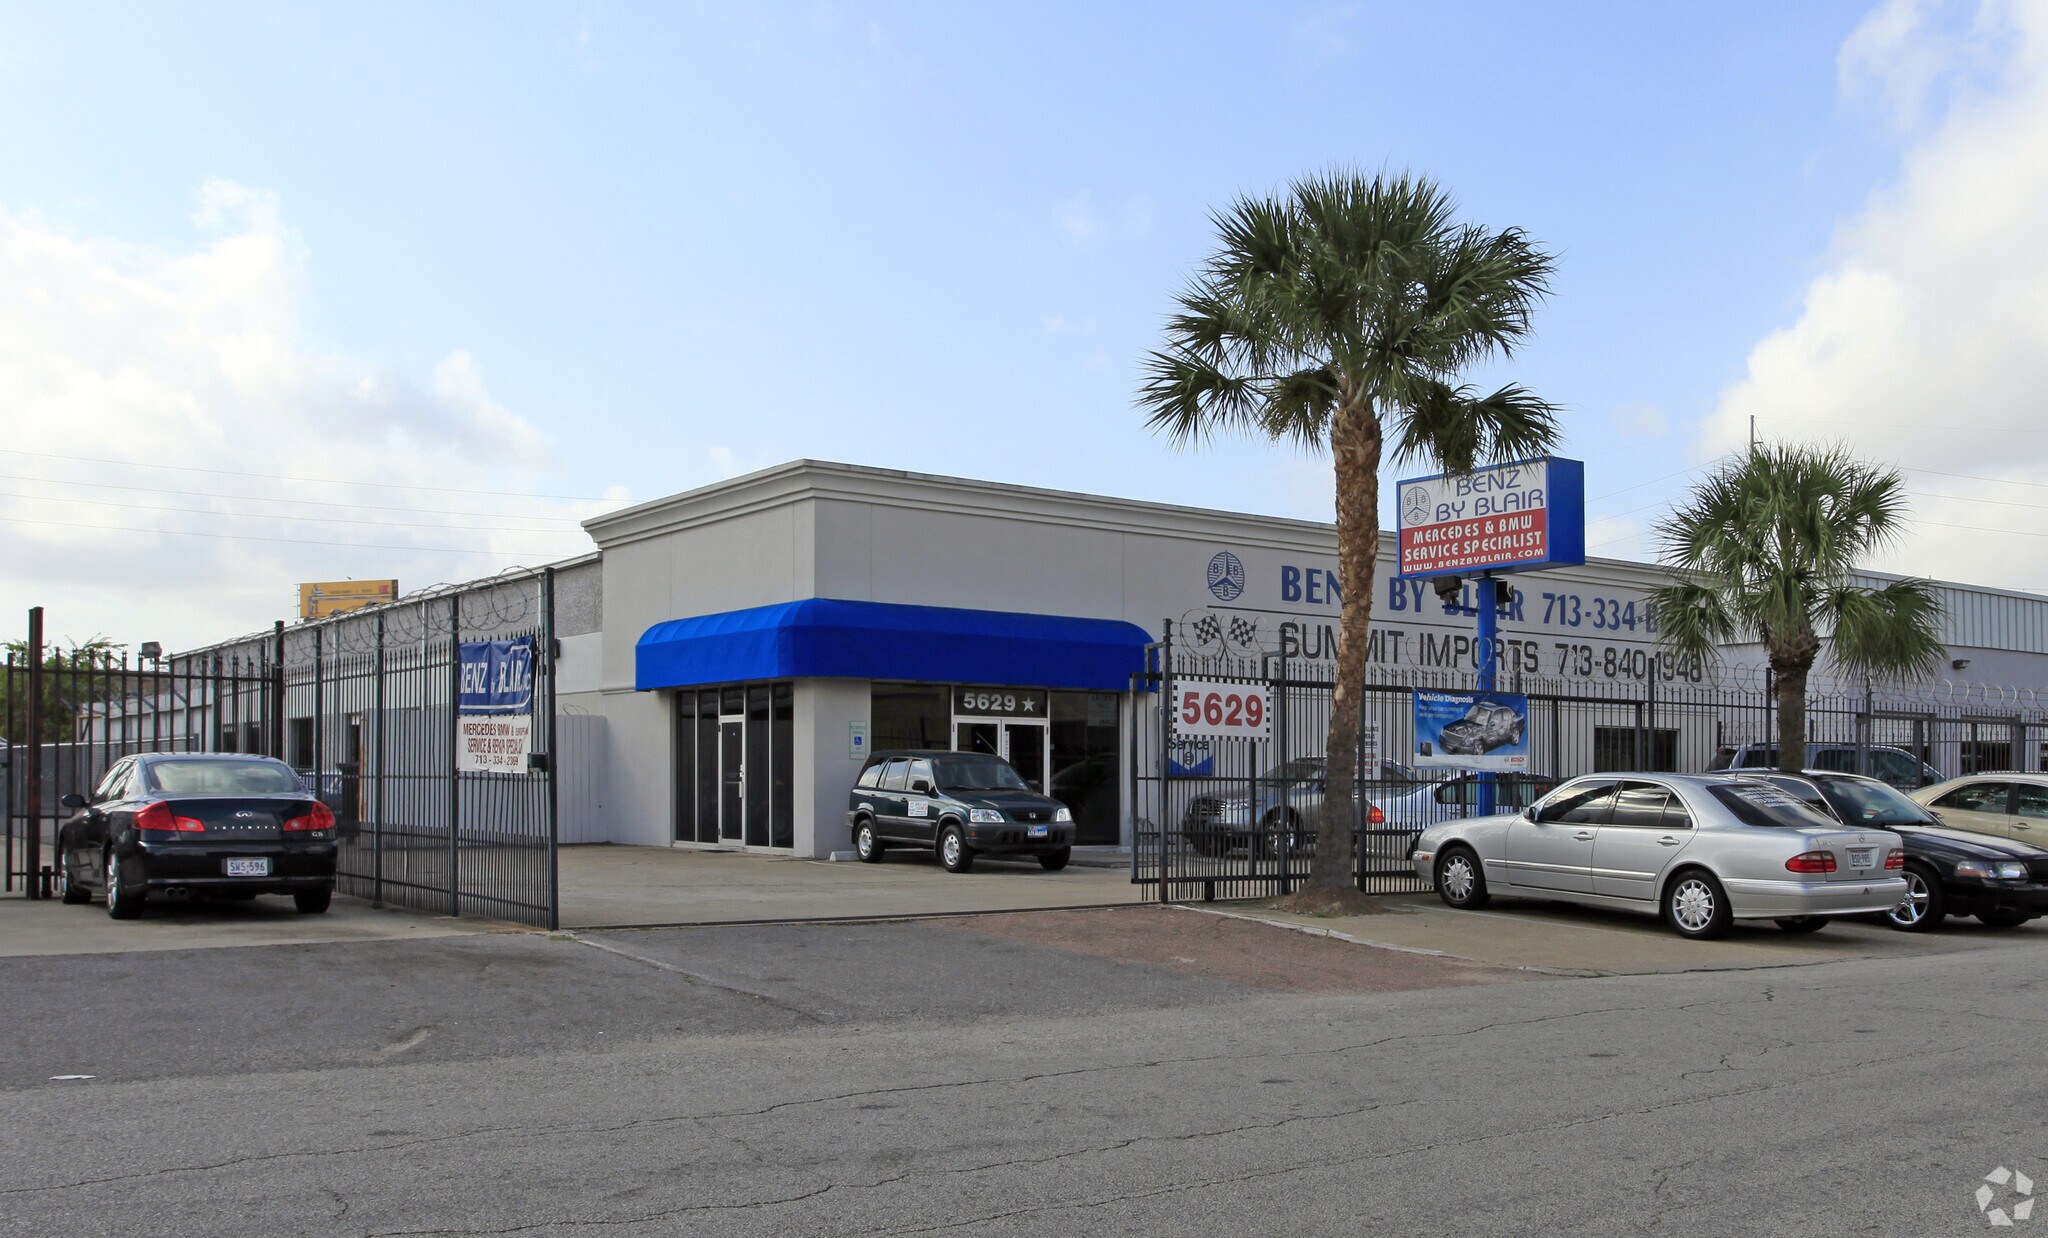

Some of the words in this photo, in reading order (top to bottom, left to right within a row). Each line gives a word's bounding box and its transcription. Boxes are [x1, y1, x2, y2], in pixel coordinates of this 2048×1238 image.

[1456, 470, 1521, 497] BENZ
[1436, 500, 1466, 523] BY
[1475, 489, 1544, 517] BLAIR
[1413, 522, 1479, 545] MERCEDES
[1485, 520, 1495, 535] &
[1500, 515, 1532, 532] BMW
[1405, 544, 1459, 563] SERVICE
[1464, 531, 1542, 555] SPECIALIST
[1281, 565, 1343, 605] BEN
[1389, 576, 1427, 613] BY
[460, 662, 488, 694] BENZ
[963, 693, 1016, 712] 5629
[1182, 691, 1263, 728] 5629
[1418, 692, 1445, 702] Vehicle
[1445, 695, 1474, 704] Diagnosis
[463, 723, 497, 736] MERCEDES
[498, 724, 511, 736] BMW
[468, 738, 487, 753] SERVICE
[487, 738, 492, 753] &
[1168, 739, 1209, 750] Service
